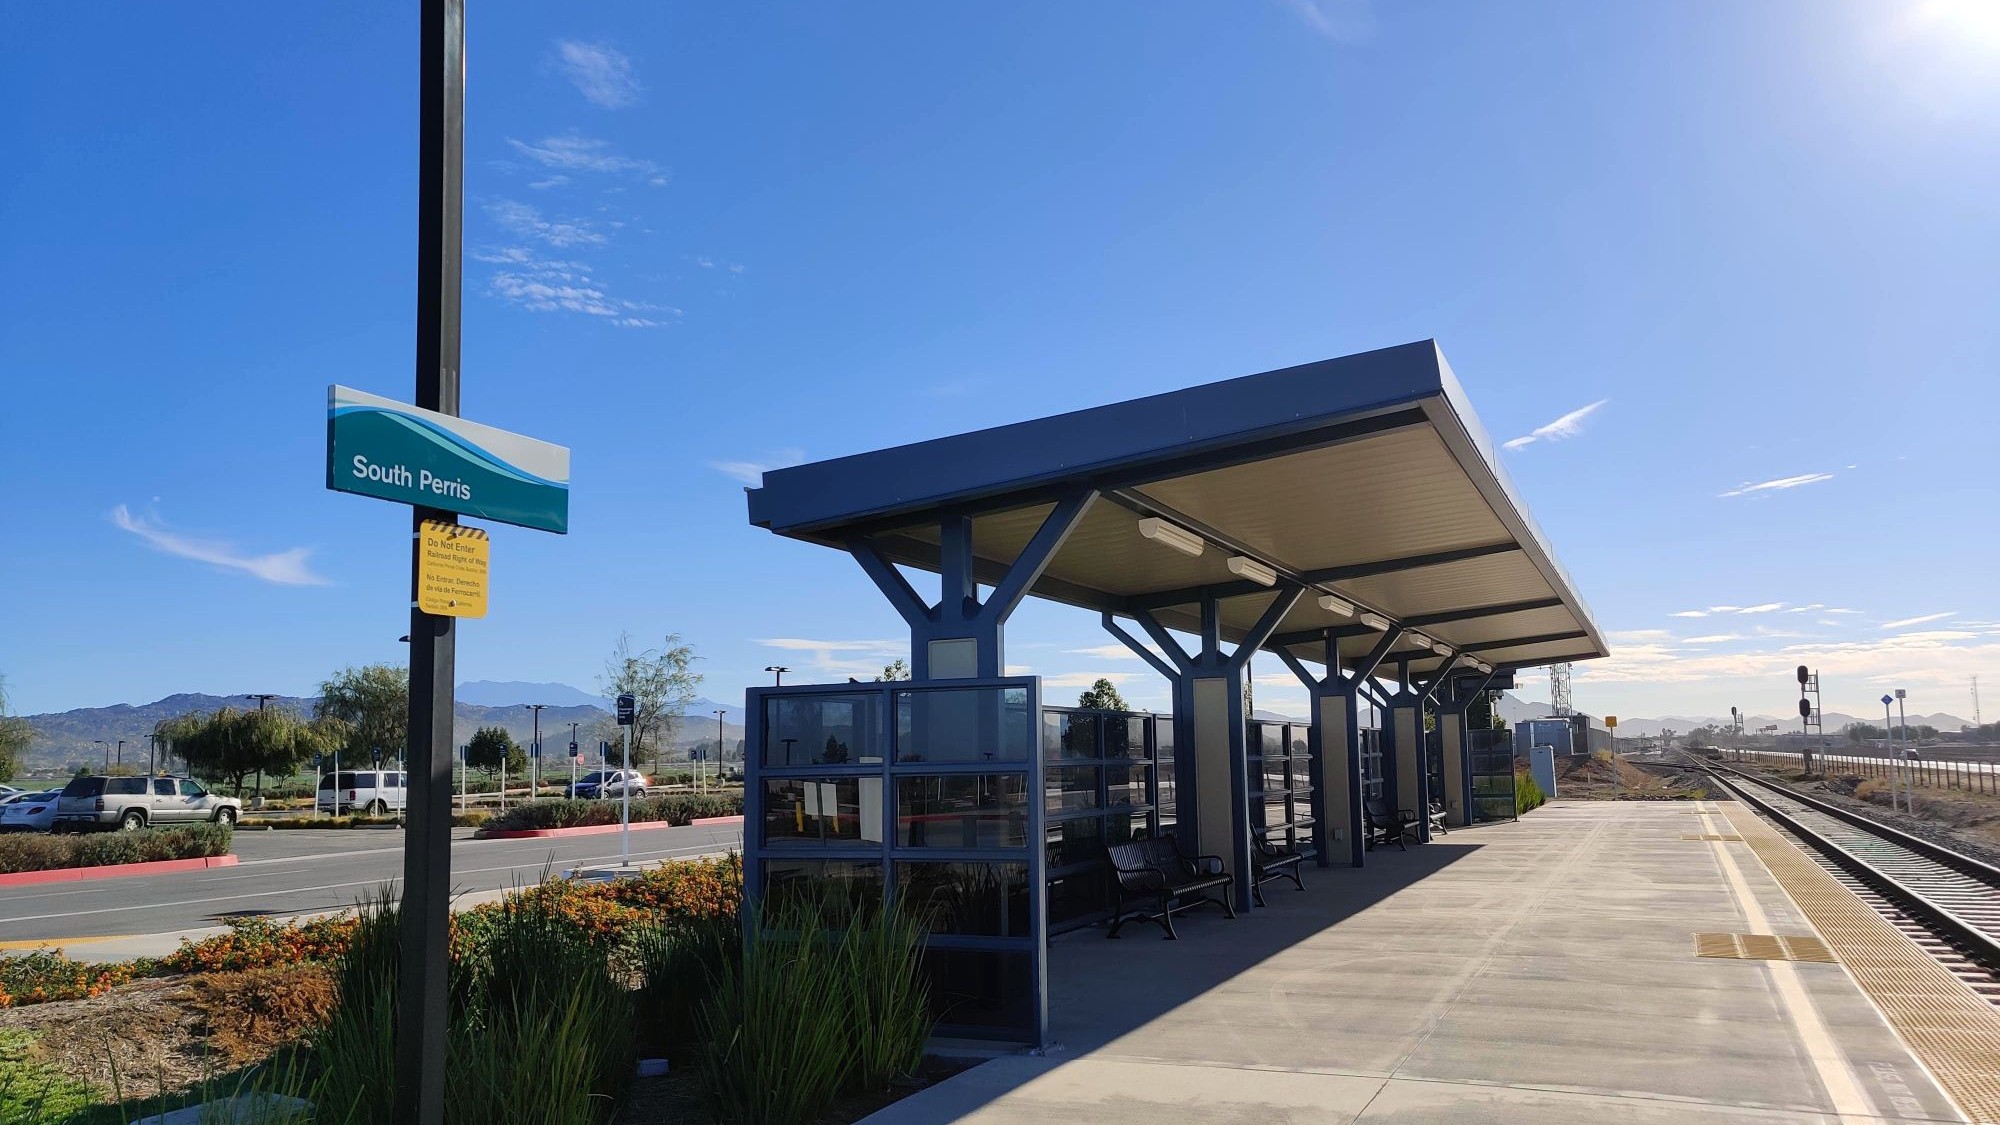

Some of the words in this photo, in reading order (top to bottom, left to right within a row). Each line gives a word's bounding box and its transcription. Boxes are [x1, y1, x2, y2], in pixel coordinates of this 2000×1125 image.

[352, 455, 413, 488] South
[419, 469, 471, 500] Perris
[428, 538, 438, 547] Do
[440, 540, 454, 550] Not
[456, 543, 476, 553] Enter
[427, 550, 451, 560] Railroad
[452, 554, 467, 563] Right
[475, 558, 486, 567] Way
